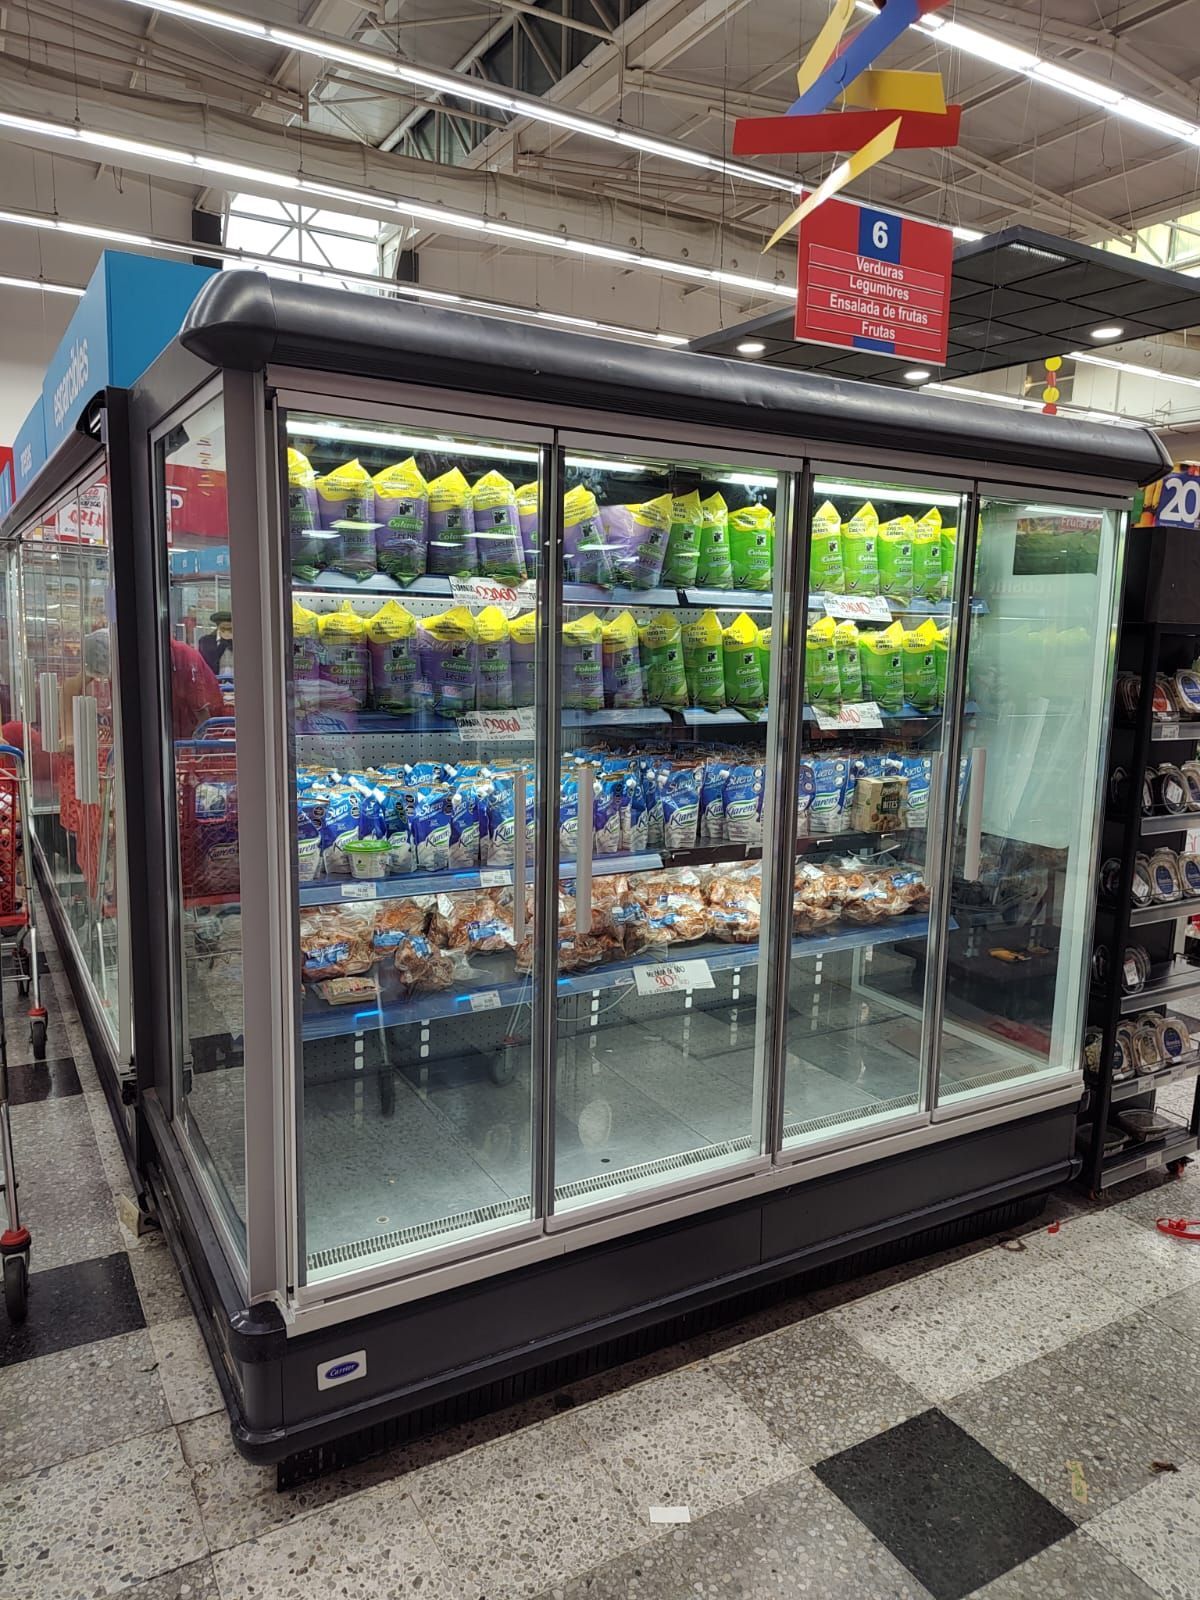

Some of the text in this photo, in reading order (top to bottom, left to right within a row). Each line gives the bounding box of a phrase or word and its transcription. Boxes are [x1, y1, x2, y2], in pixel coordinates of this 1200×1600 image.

[872, 221, 888, 249] 6
[856, 257, 903, 280] Verduras
[849, 275, 909, 301] Legumbres
[830, 294, 928, 325] Ensalada de frutas
[861, 321, 896, 340] Frutas
[1159, 477, 1200, 523] 20
[727, 774, 752, 786] Suero
[330, 1364, 356, 1377] Carrier
